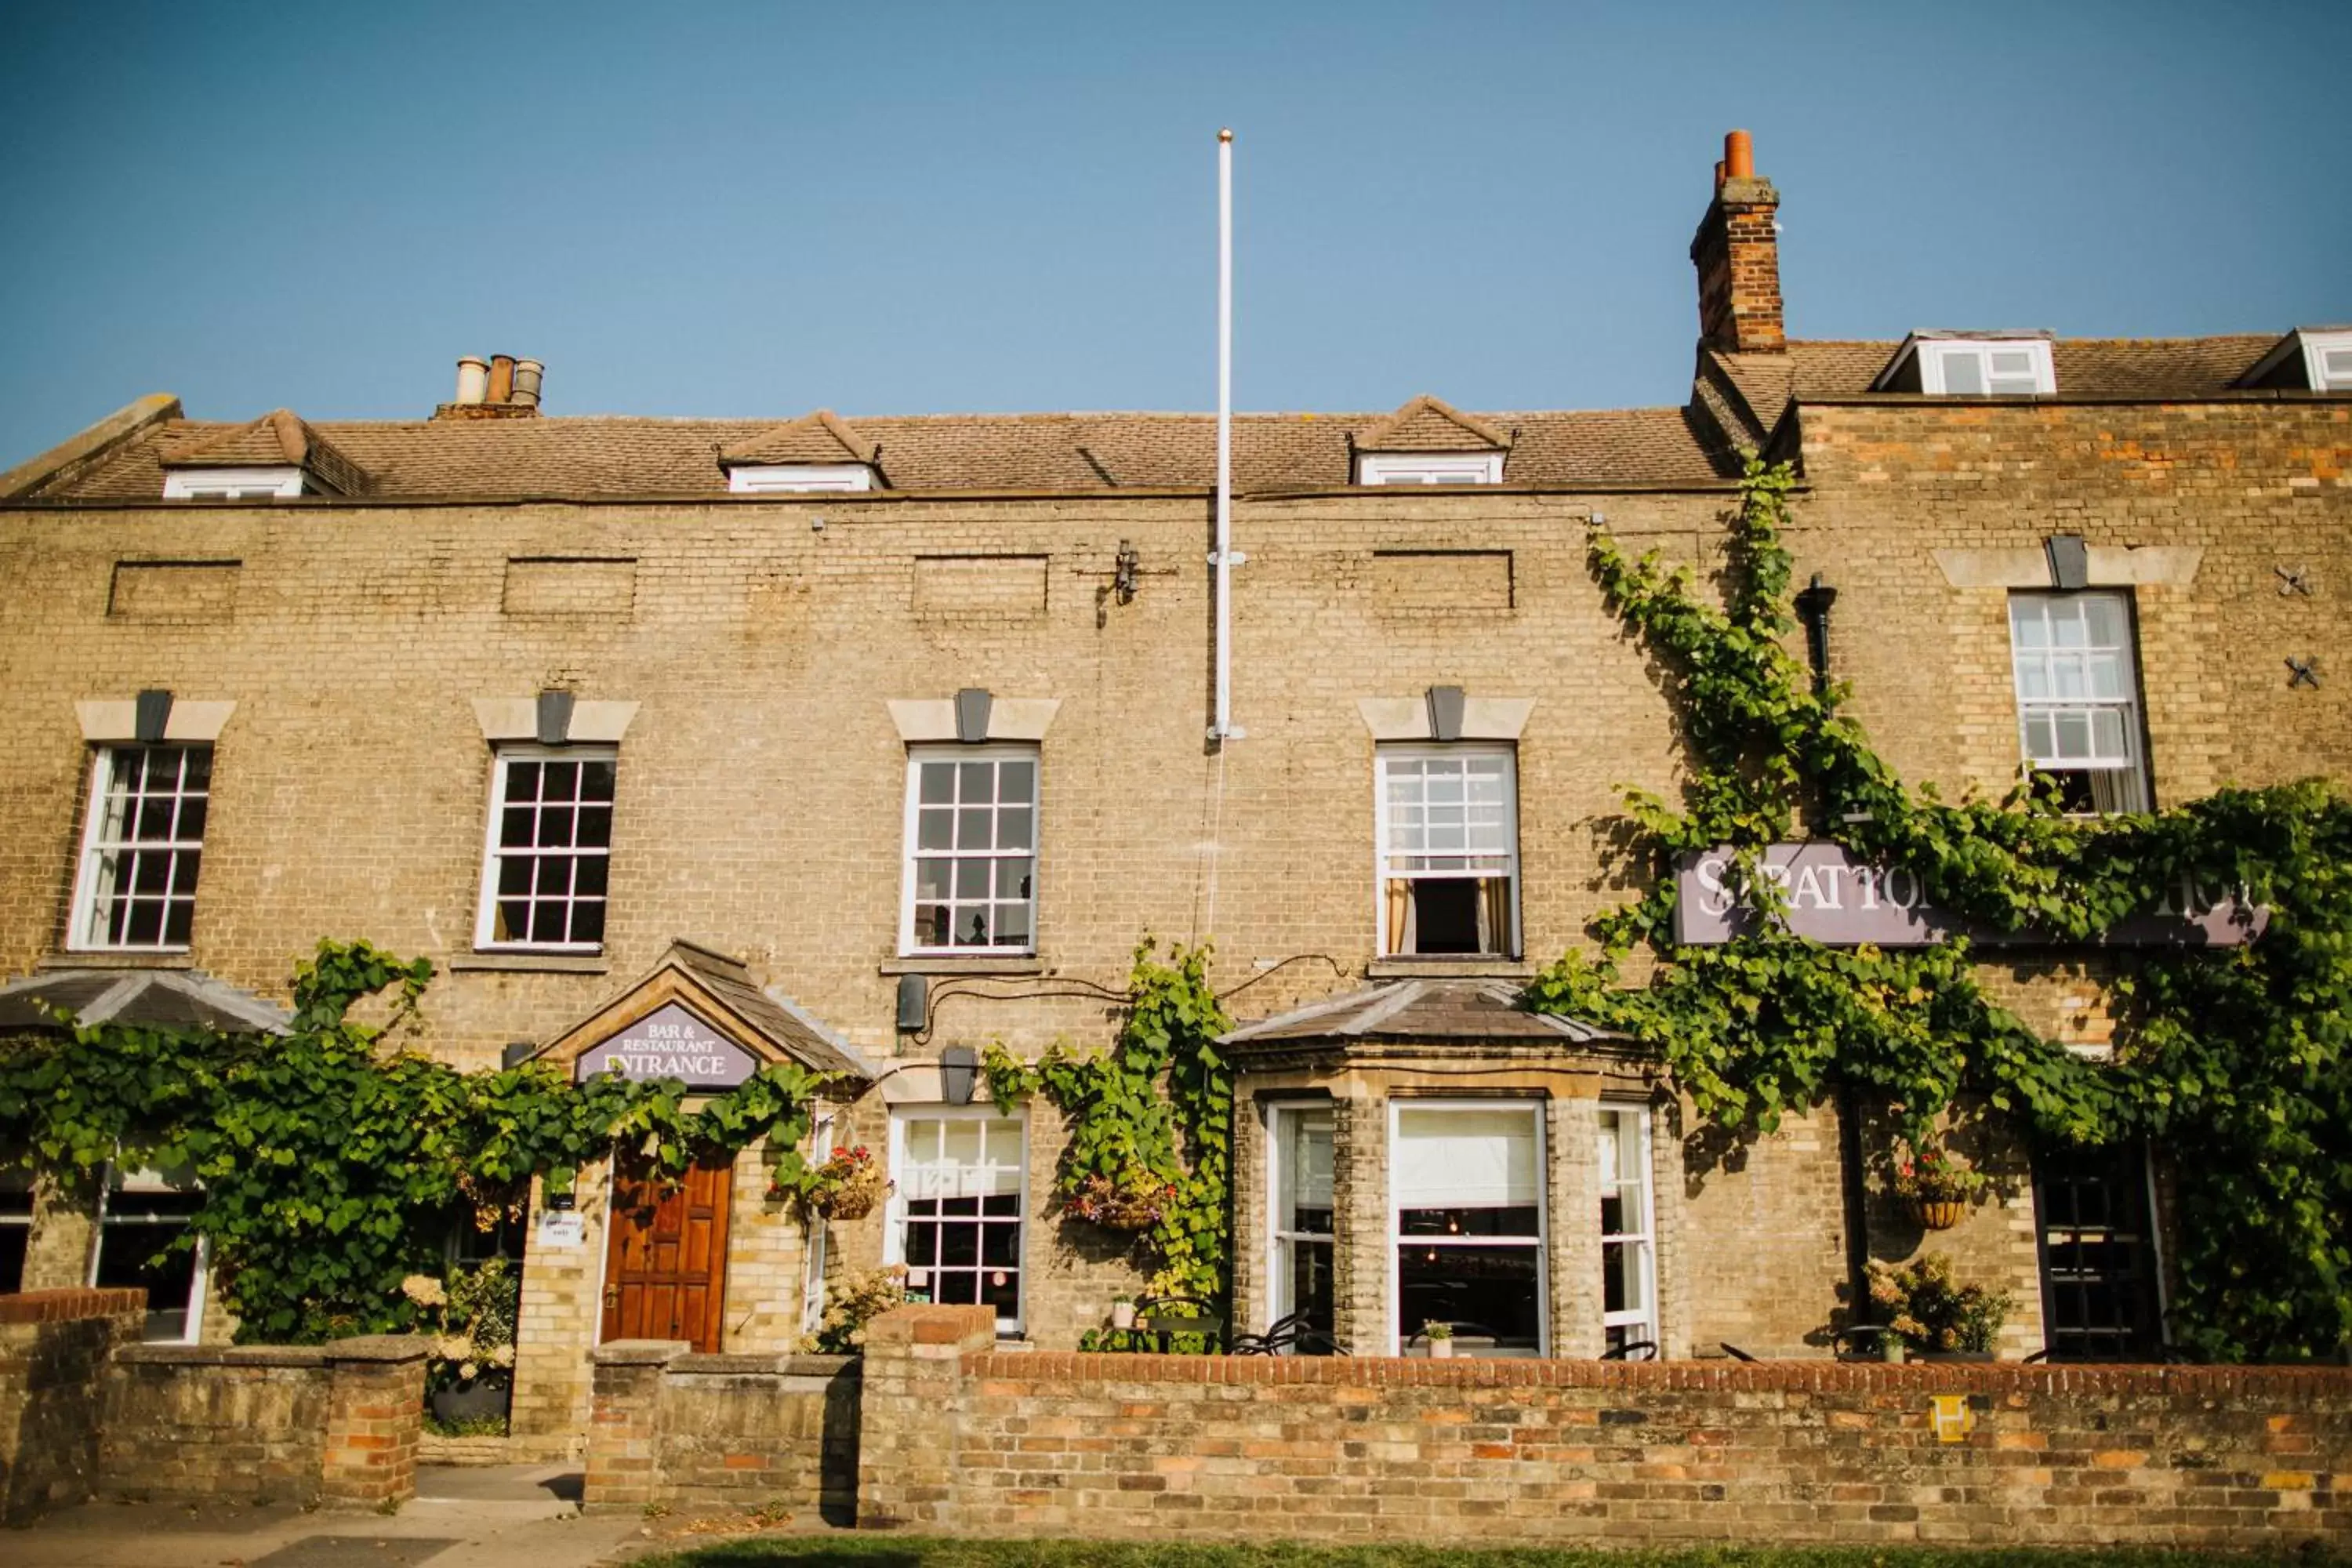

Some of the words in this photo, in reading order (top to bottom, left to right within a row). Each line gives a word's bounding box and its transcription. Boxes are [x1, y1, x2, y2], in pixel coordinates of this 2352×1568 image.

[648, 1024, 681, 1040] BAR
[683, 1025, 695, 1040] &
[622, 1039, 716, 1053] RESTAURANT
